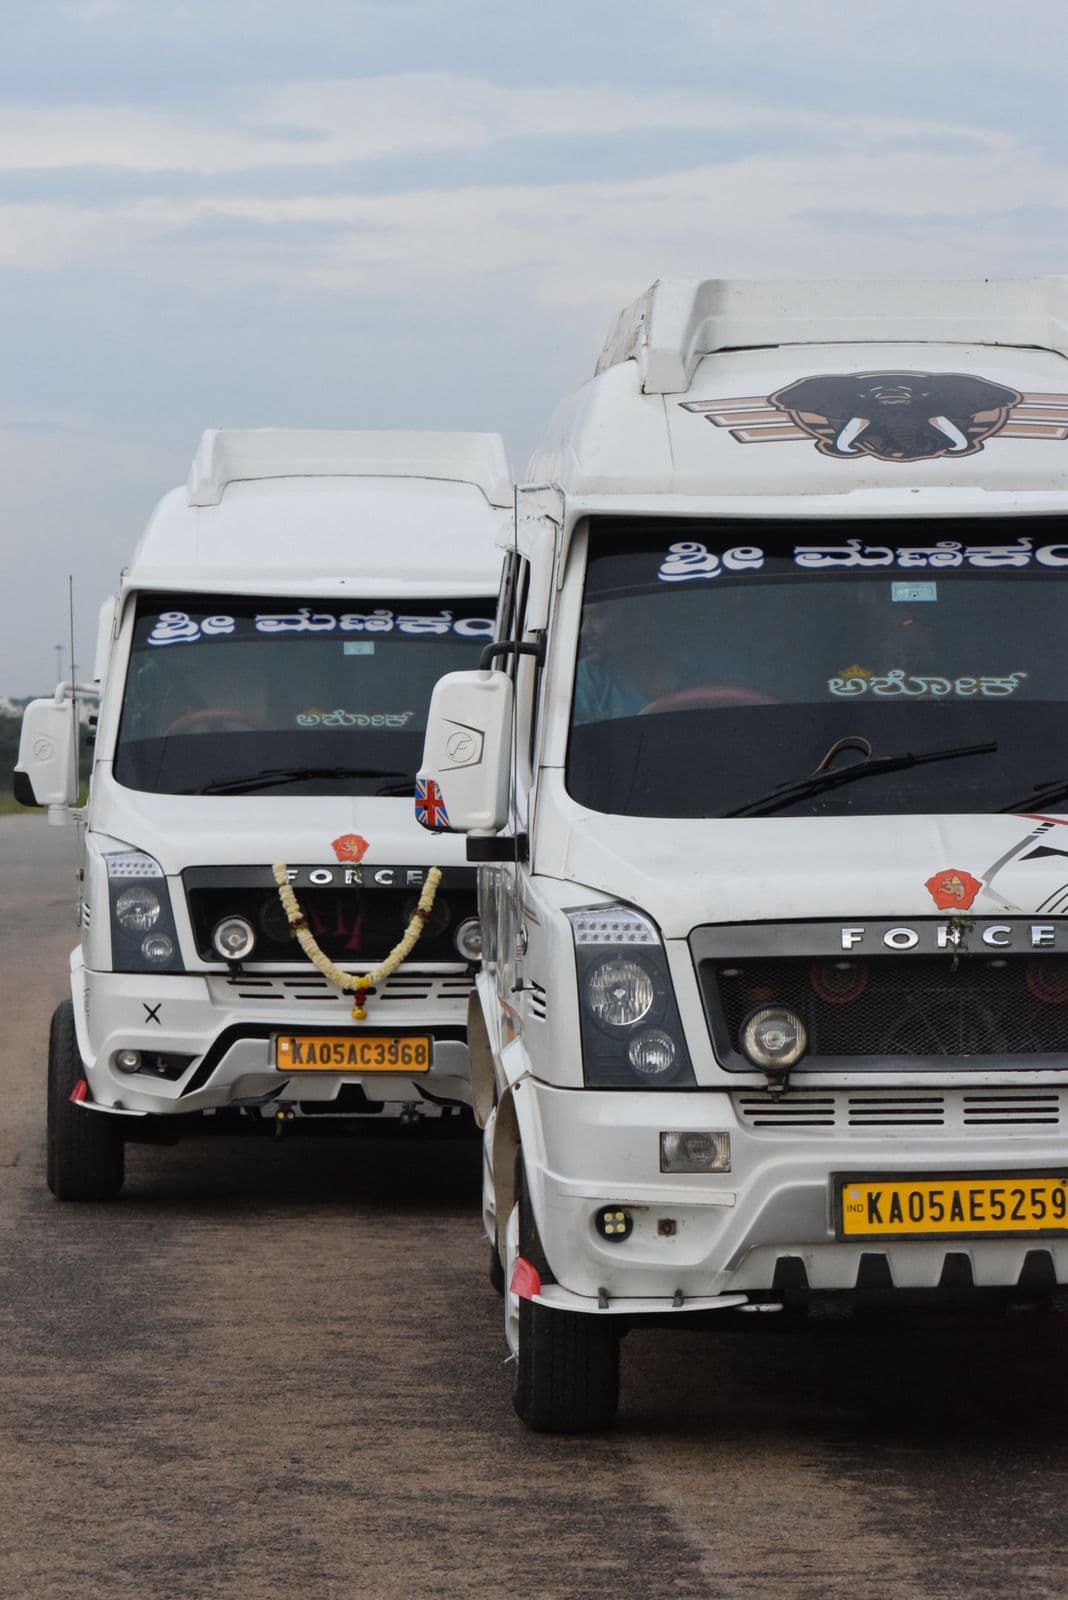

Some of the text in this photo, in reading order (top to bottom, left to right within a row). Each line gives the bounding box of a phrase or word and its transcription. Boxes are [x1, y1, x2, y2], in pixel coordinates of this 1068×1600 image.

[657, 541, 765, 582] ಶ್ರೀ
[147, 611, 236, 646] ಶ್ರೀ
[827, 669, 1028, 697] ಅಶೋಕ್
[296, 708, 414, 727] ಅಶೋಕ್
[286, 869, 424, 885] FORCE
[841, 925, 1055, 950] FORCE
[291, 1042, 427, 1065] KA05AC3968
[846, 1187, 1067, 1225] IND KA05AE5259
